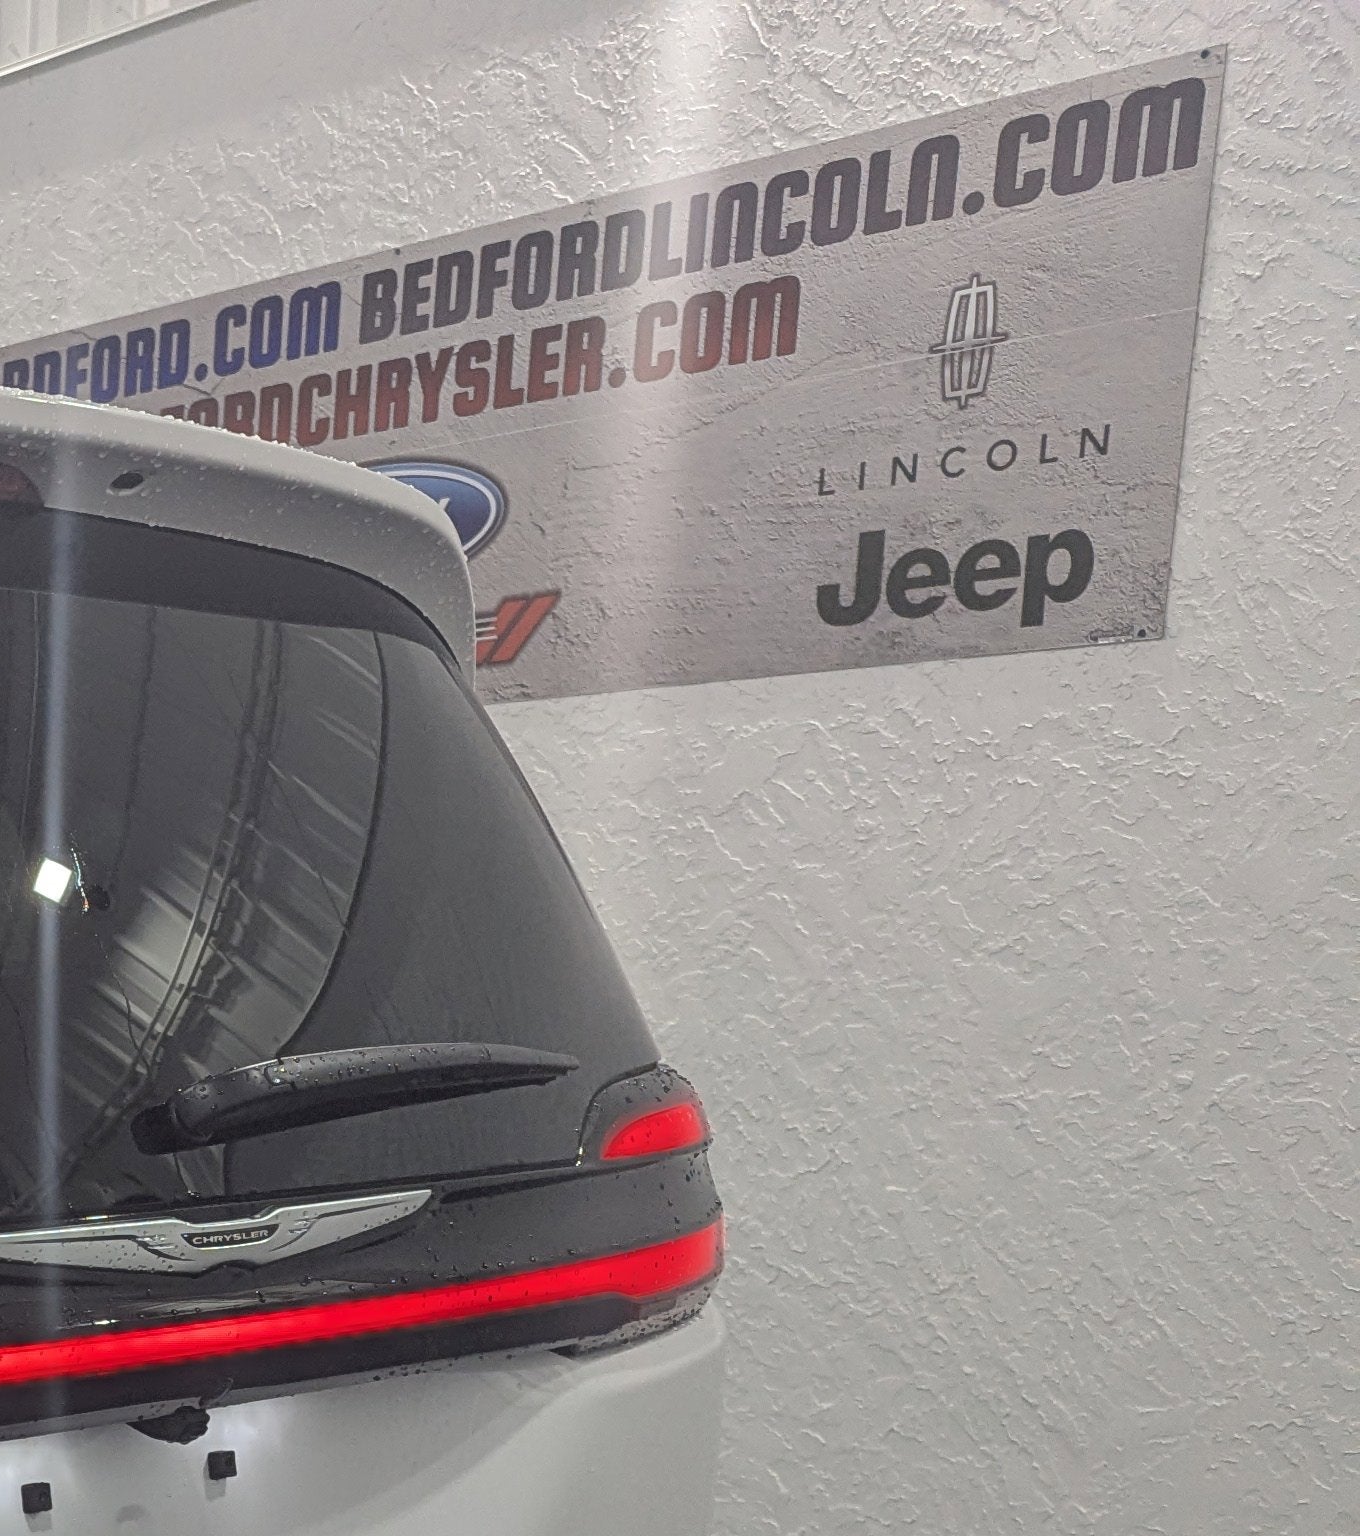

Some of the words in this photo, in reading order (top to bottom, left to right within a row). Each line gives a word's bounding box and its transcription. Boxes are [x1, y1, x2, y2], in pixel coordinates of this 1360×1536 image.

[359, 77, 1206, 345] BEDFORDLINCOLN.COM
[159, 275, 801, 447] RDCHRYSLER.COM
[817, 424, 1111, 497] LINCOLN
[816, 528, 1095, 628] Jeep
[192, 1229, 269, 1245] CHRYSLER
